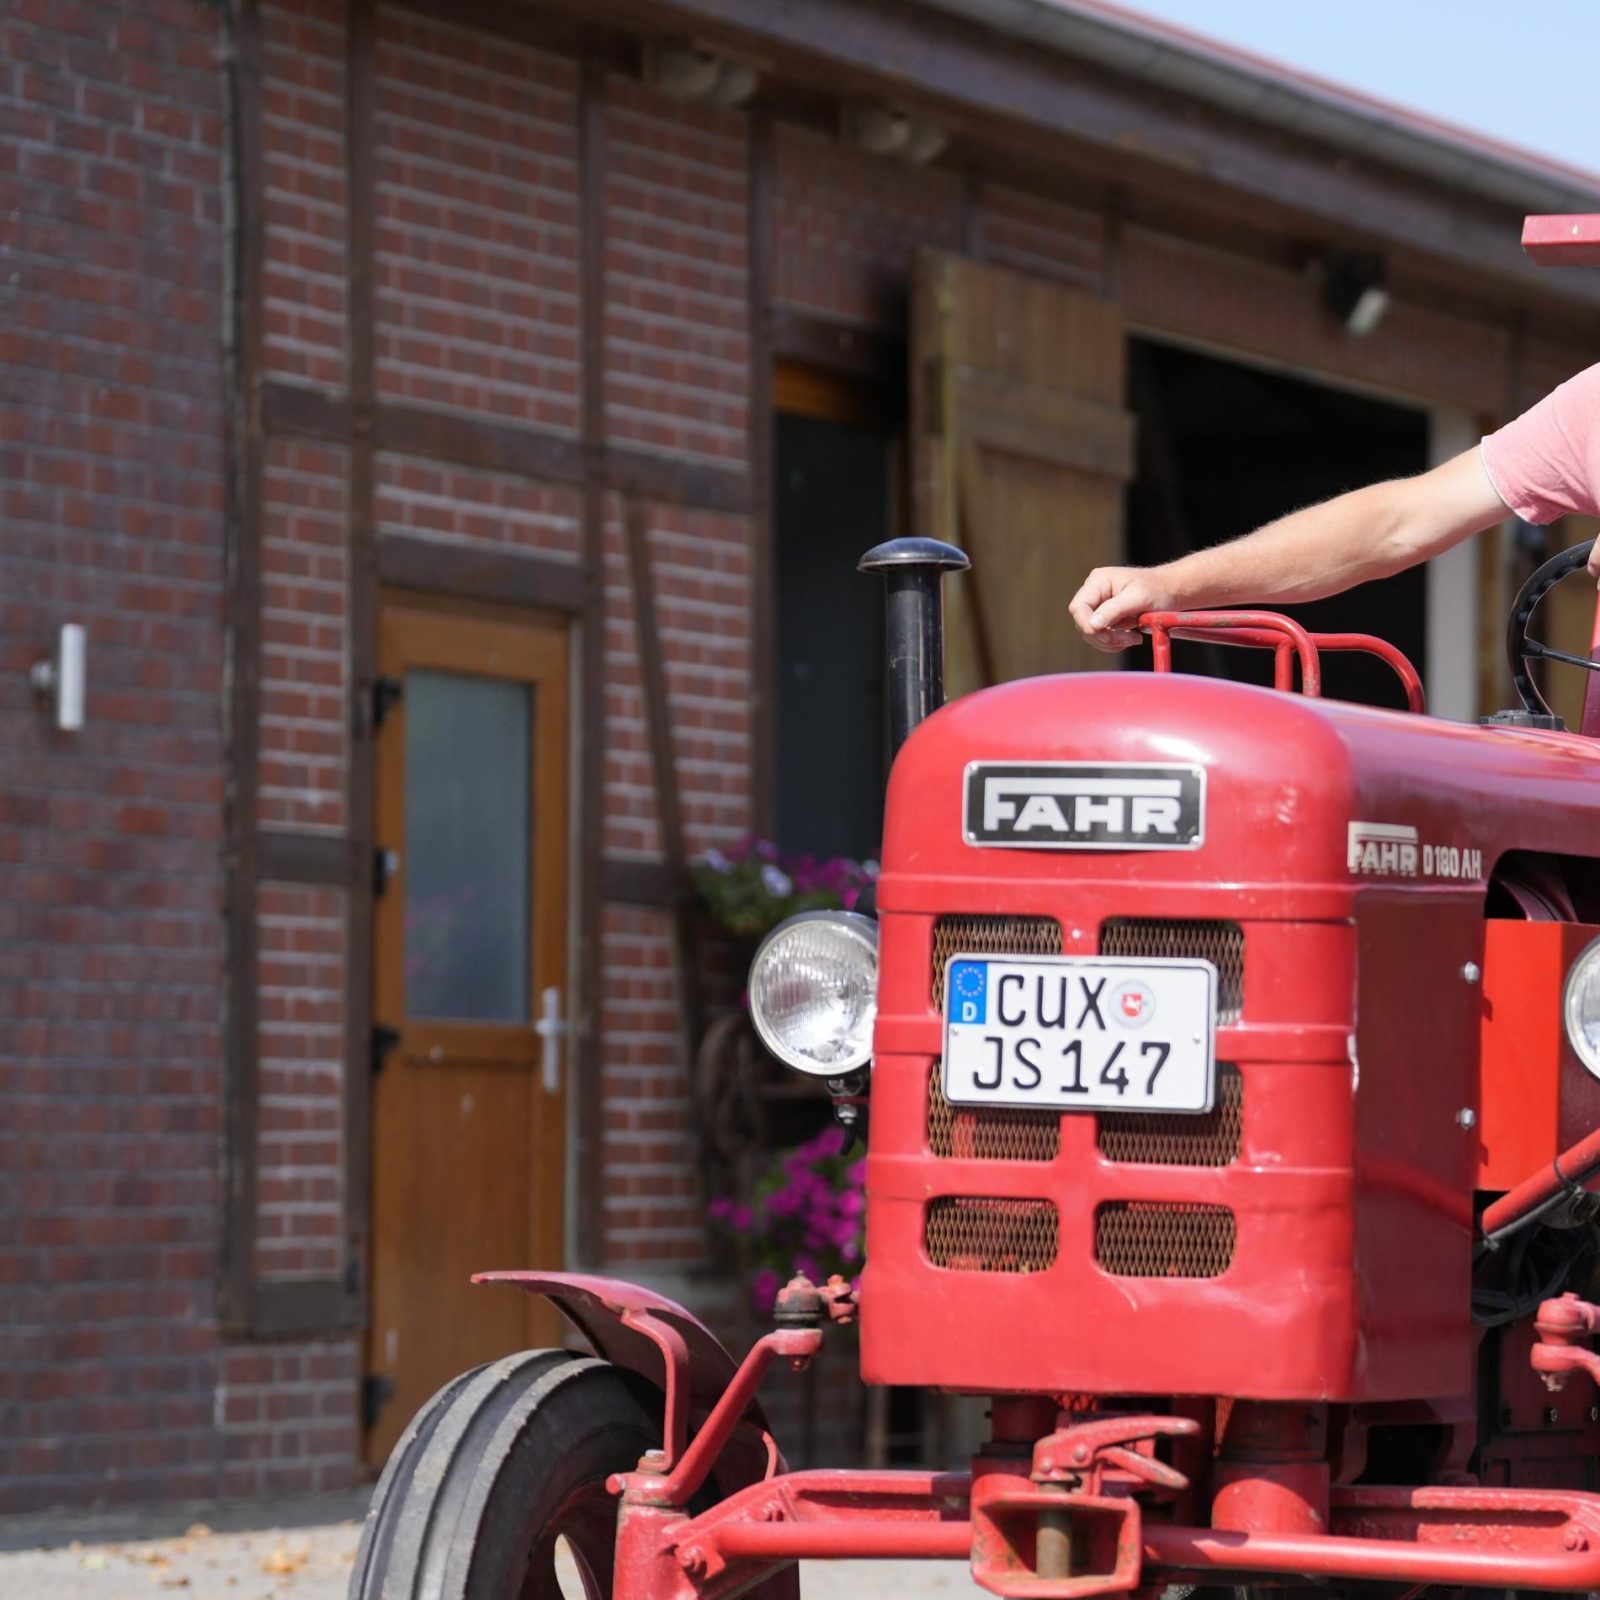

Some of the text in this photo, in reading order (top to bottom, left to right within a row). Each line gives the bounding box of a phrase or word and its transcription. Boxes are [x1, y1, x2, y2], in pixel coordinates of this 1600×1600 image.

[984, 777, 1181, 833] FAHR
[1347, 821, 1417, 876] FAHR
[962, 1001, 977, 1022] D
[998, 974, 1107, 1030] CUX
[972, 1036, 1171, 1095] JS 147
